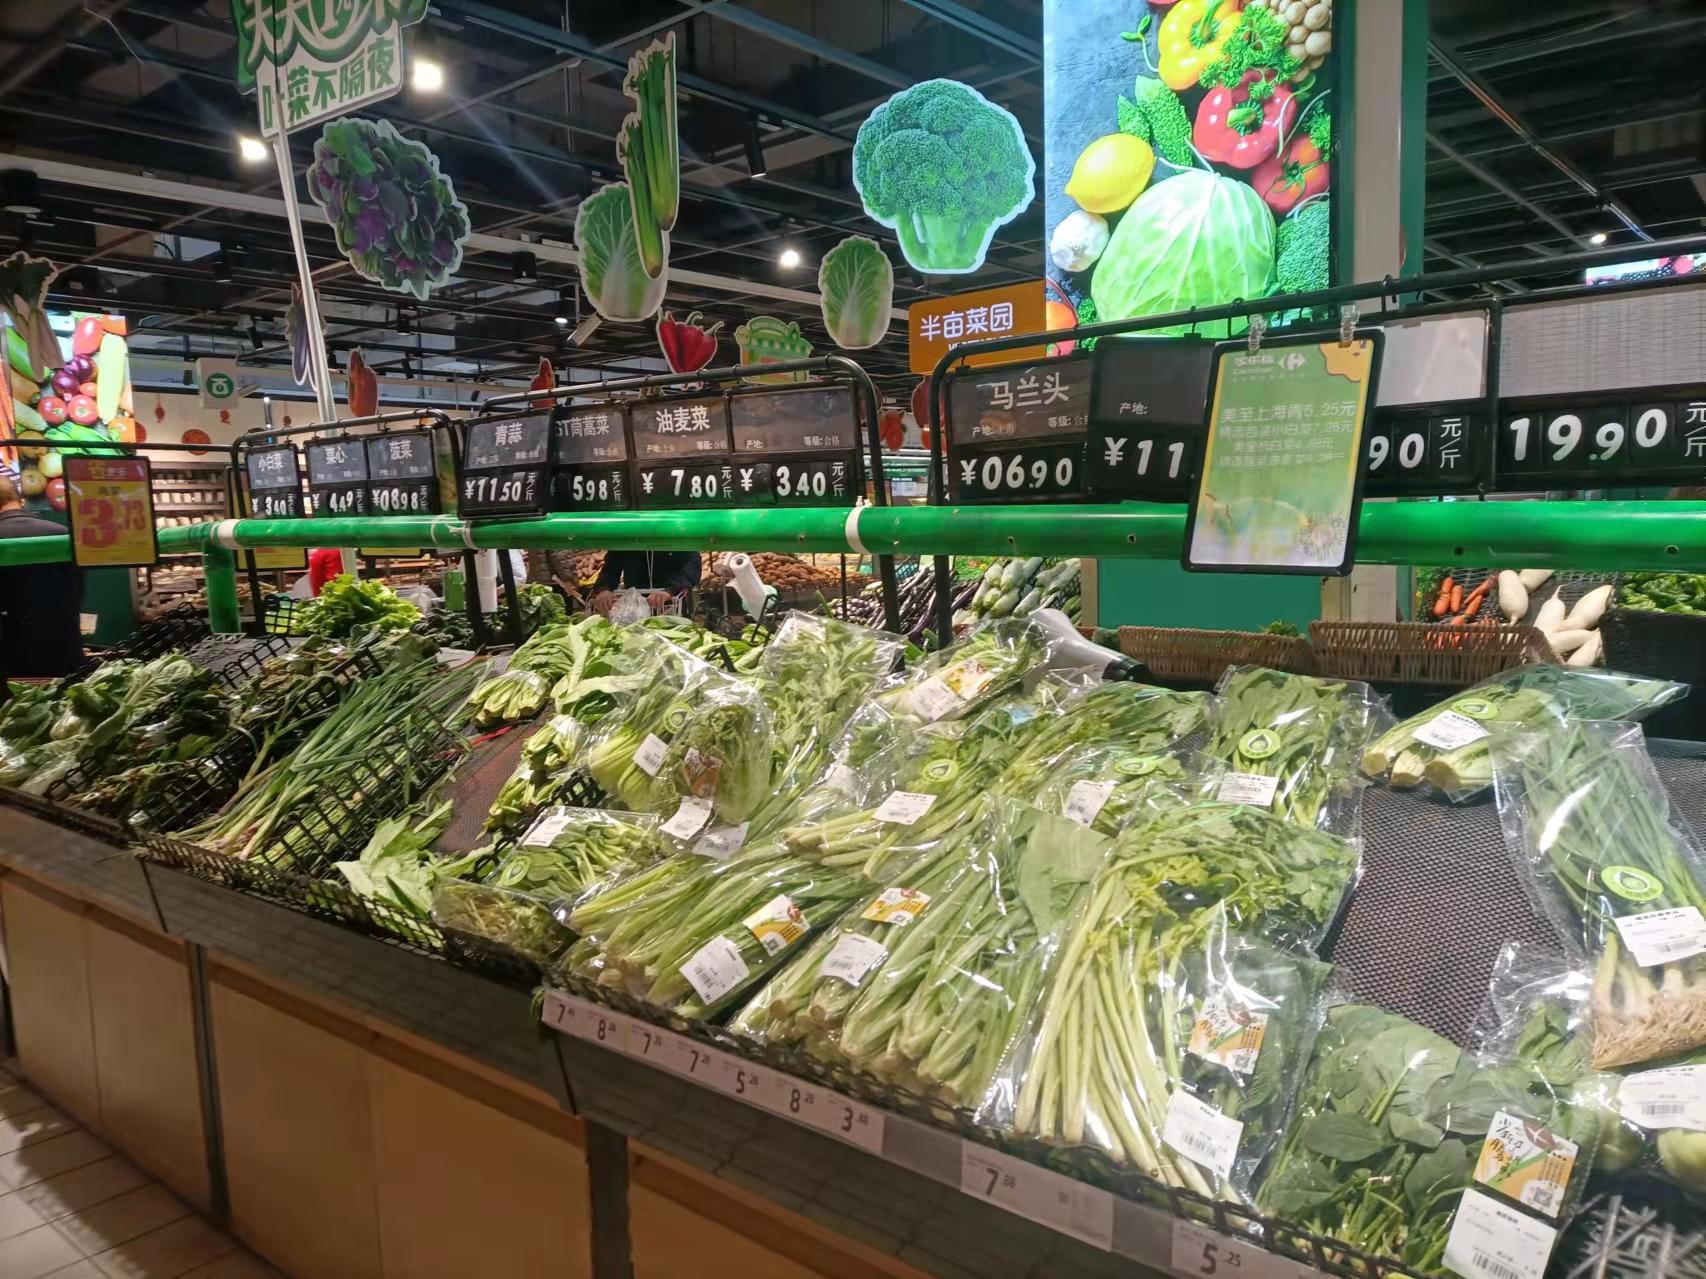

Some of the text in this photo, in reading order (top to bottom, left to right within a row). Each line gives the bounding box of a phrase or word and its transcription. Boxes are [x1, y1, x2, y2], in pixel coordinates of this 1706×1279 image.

[920, 302, 1013, 342] 半亩菜园
[990, 372, 1069, 410] 马兰头
[495, 422, 523, 447] 青蒜
[656, 405, 710, 433] 油麦菜
[1510, 408, 1667, 461] 19.90
[258, 453, 284, 472] 小白菜
